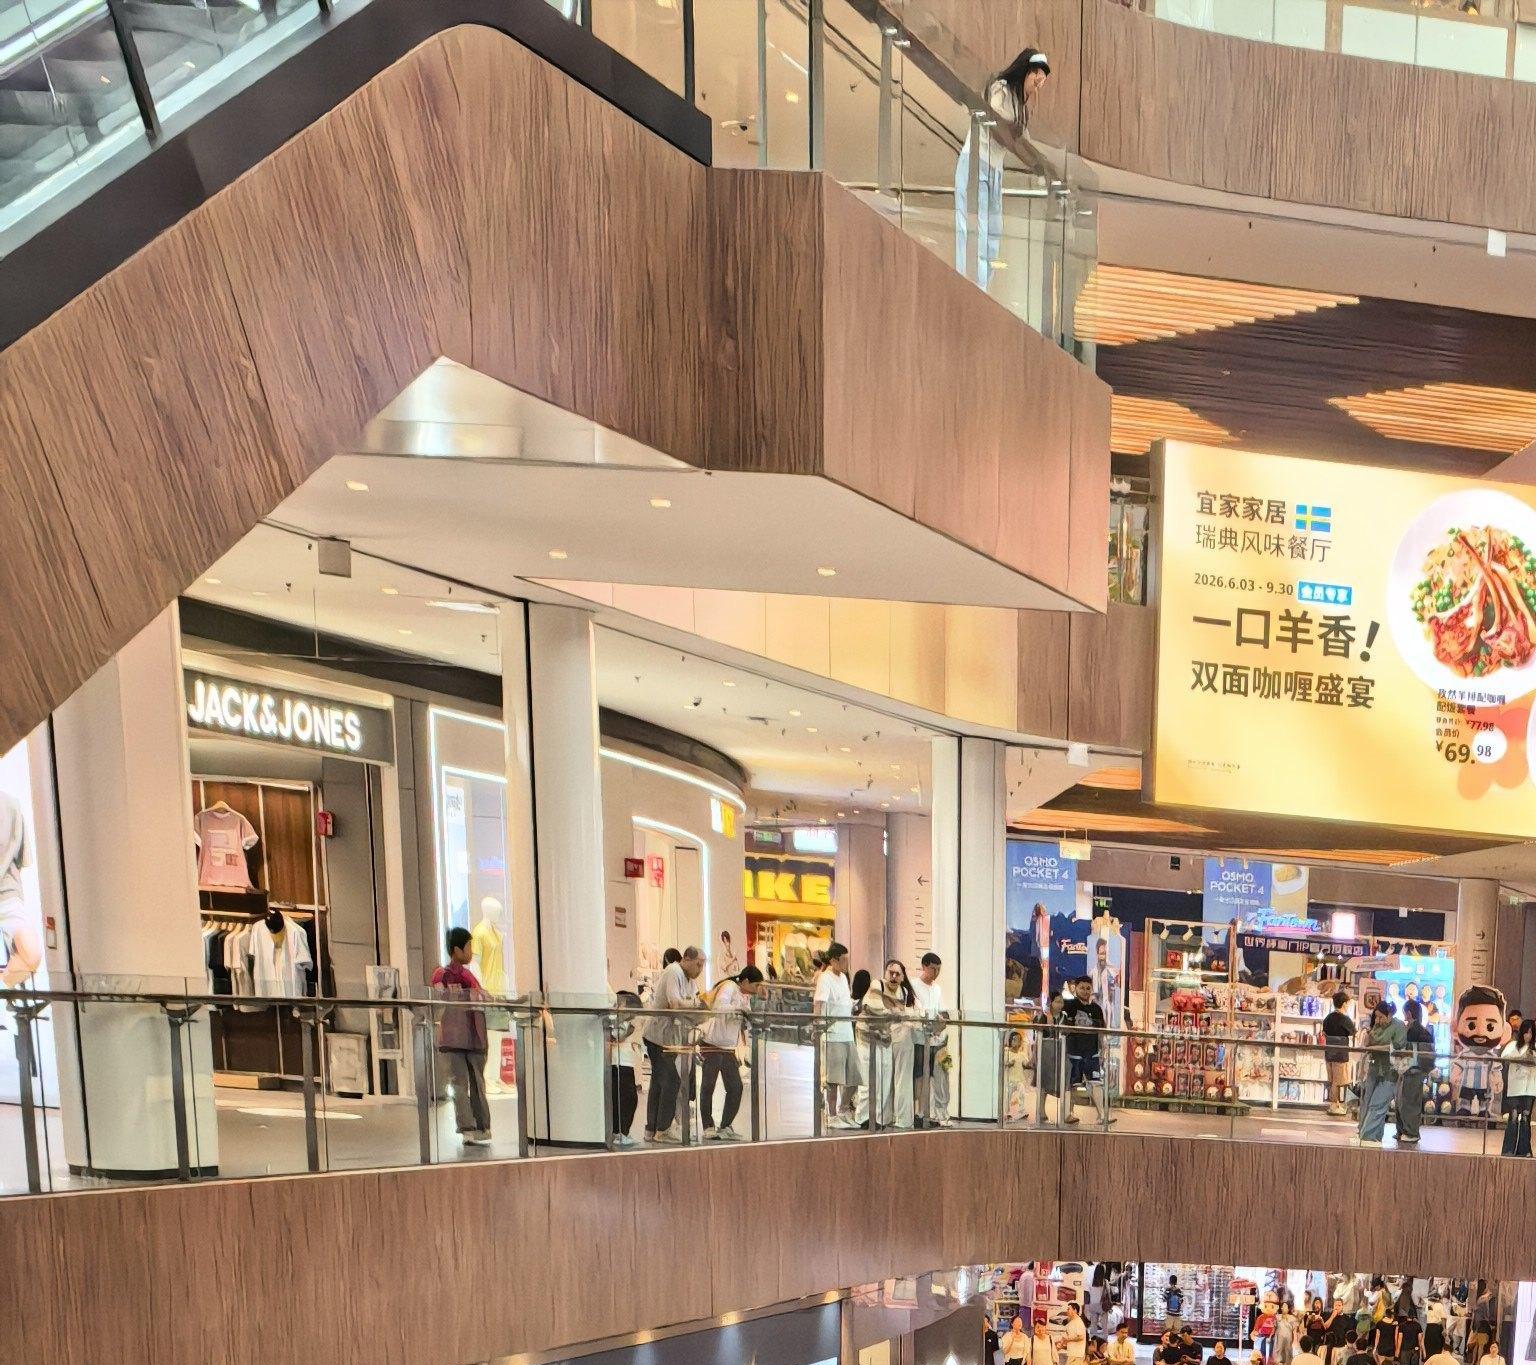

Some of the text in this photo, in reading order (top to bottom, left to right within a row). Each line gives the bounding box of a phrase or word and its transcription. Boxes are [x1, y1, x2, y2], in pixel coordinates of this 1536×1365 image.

[1197, 491, 1287, 525] 宜家家居
[1196, 524, 1332, 563] 瑞典风味餐厅
[1191, 660, 1375, 709] 双面咖喱盛宴
[187, 679, 362, 752] JACK&JONES
[1013, 866, 1069, 880] POCKET 4
[1024, 856, 1059, 868] OSMO
[1210, 881, 1256, 894] POCKET
[1221, 871, 1254, 883] OSMO
